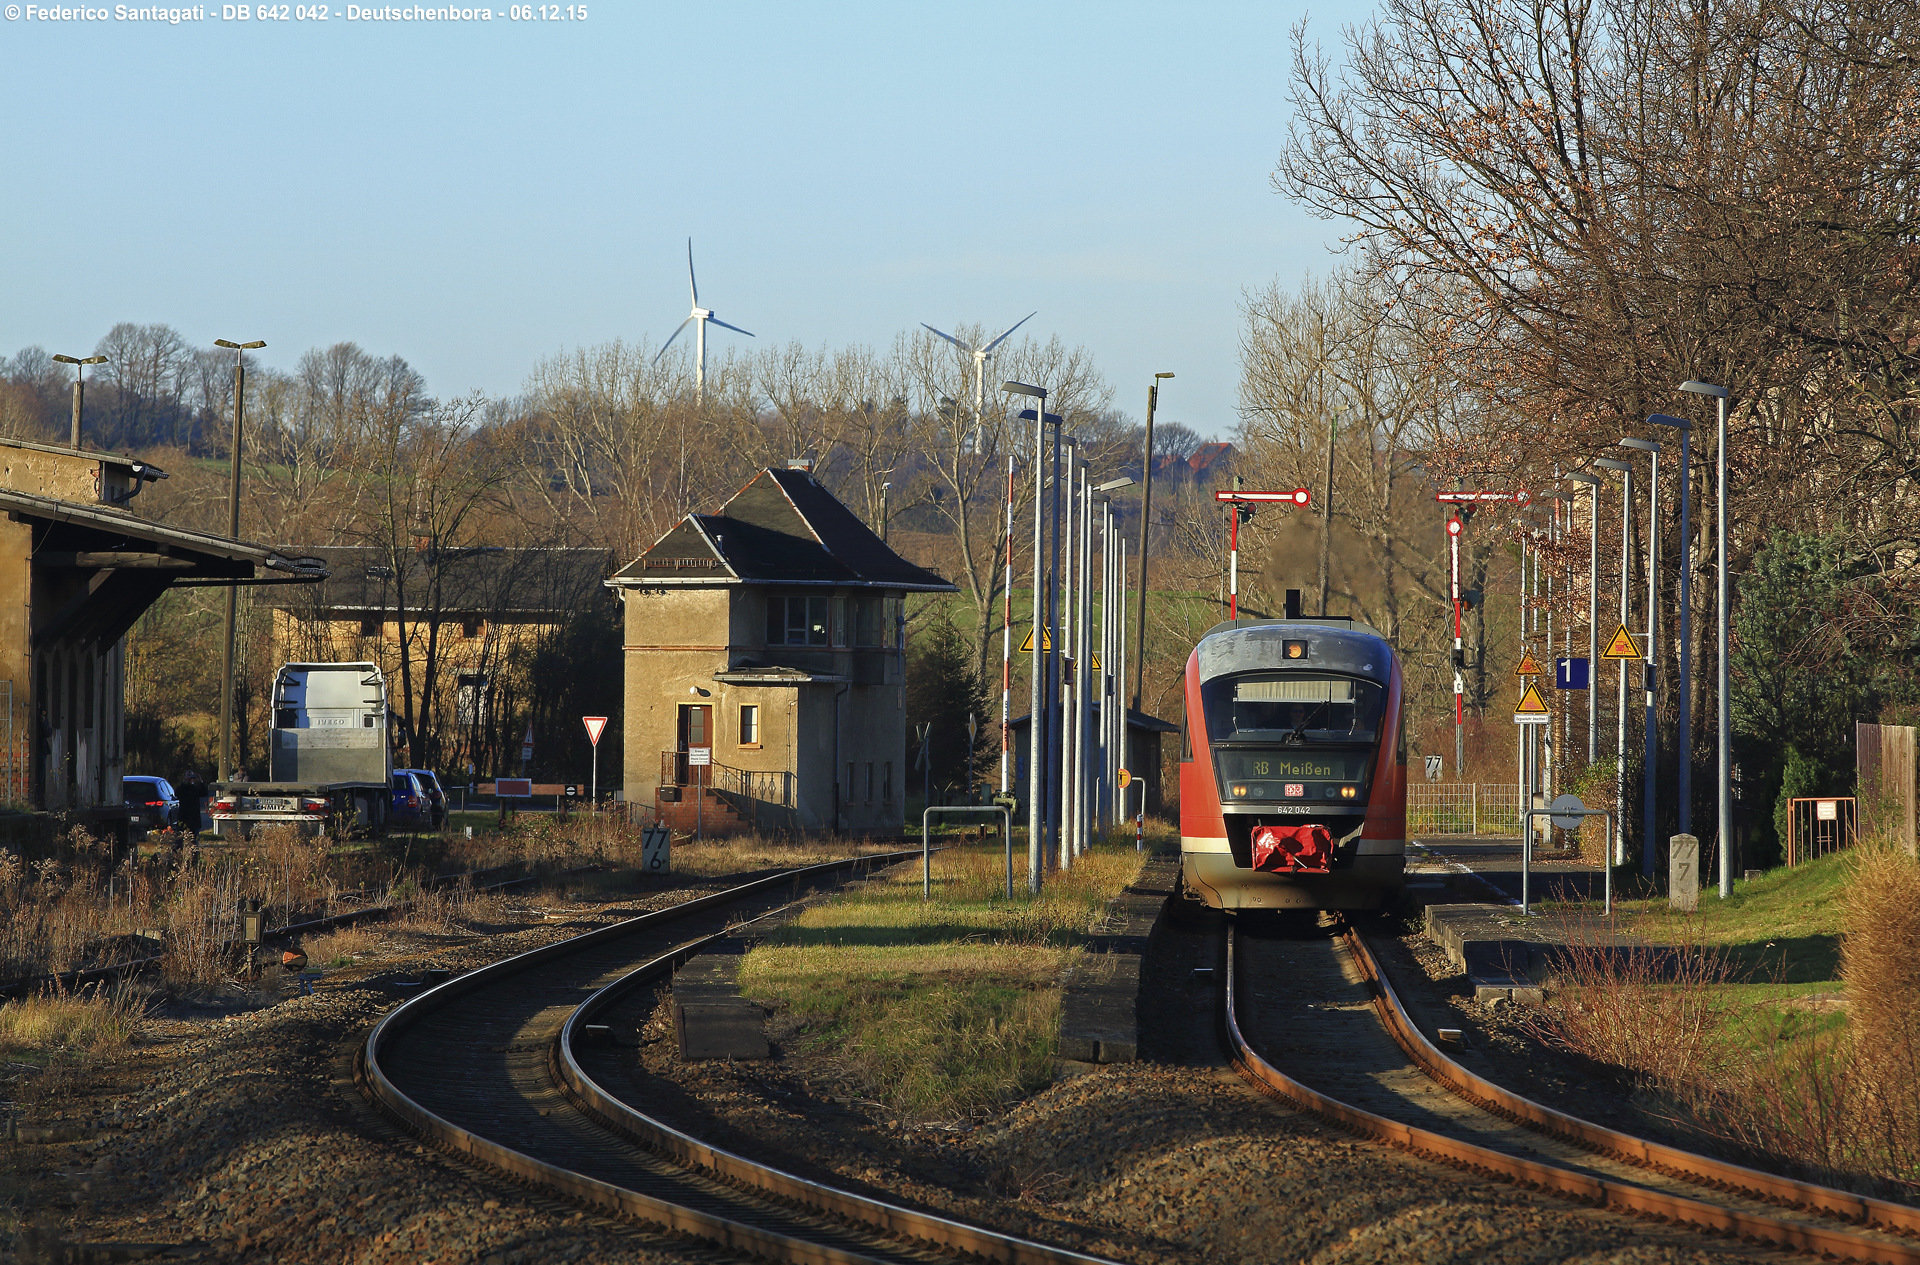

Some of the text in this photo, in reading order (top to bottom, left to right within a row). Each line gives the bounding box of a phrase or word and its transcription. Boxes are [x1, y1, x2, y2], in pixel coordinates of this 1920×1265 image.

[1560, 659, 1571, 683] 1
[1253, 761, 1331, 775] RB Meißen
[1425, 756, 1441, 769] 77
[1277, 806, 1311, 814] 642 042
[644, 829, 668, 849] 77
[1672, 840, 1697, 859] 77
[650, 851, 661, 870] 6
[1679, 862, 1690, 881] 7
